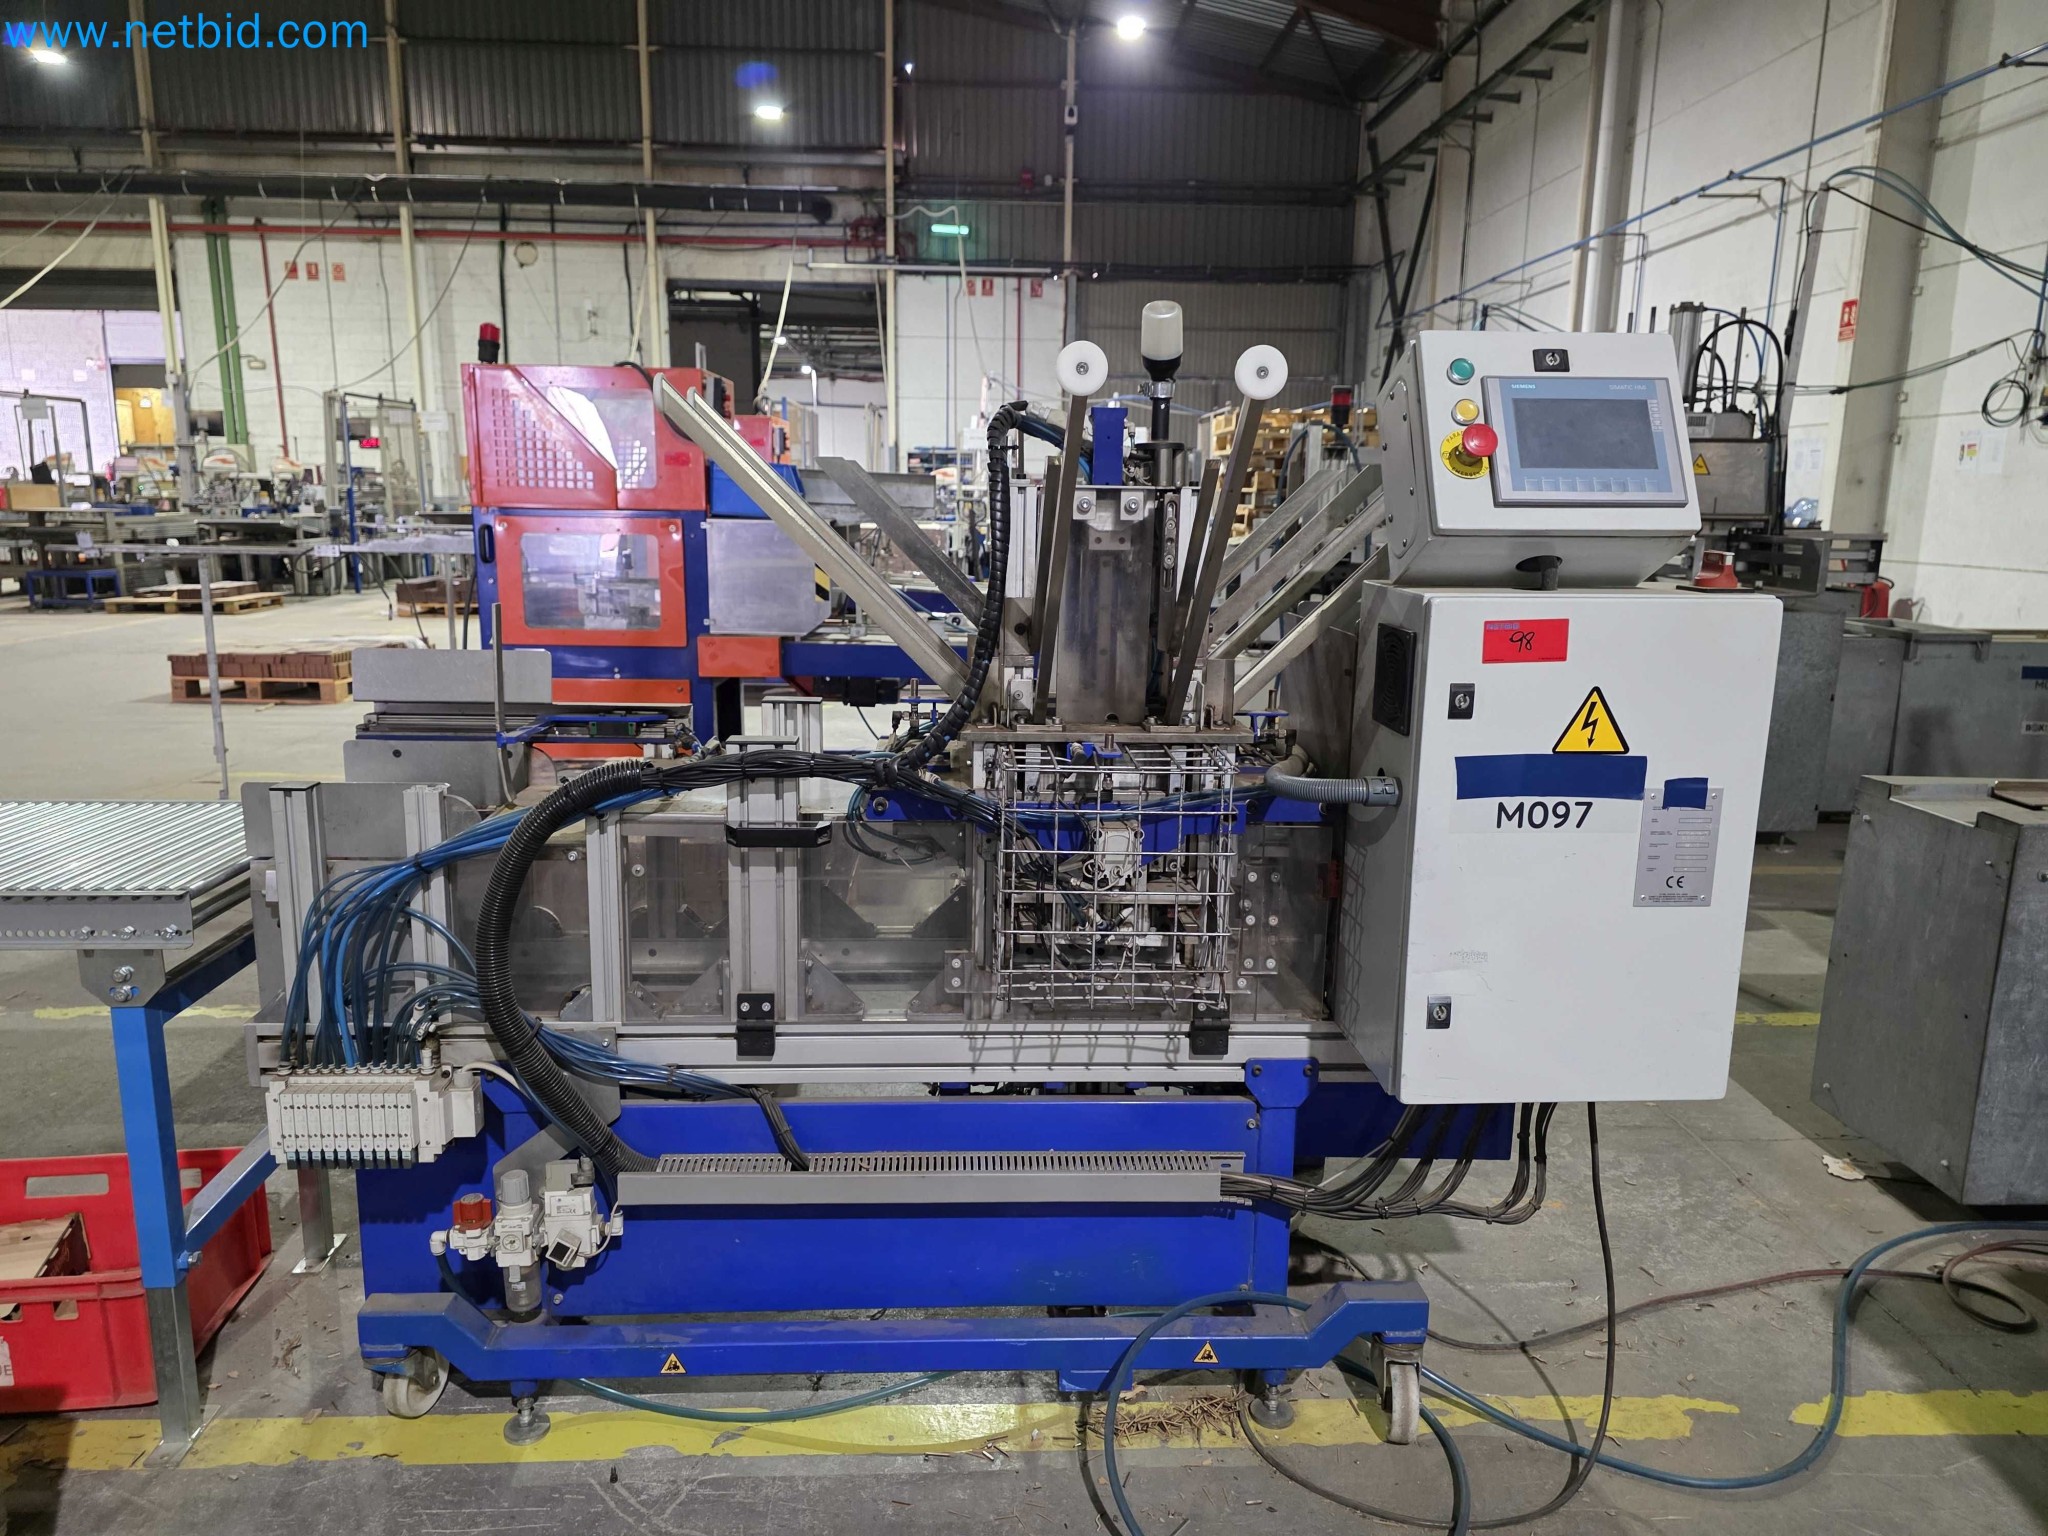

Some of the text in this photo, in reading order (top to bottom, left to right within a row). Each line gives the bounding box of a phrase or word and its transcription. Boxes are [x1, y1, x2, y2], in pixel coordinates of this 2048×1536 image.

[1649, 400, 1664, 431] TOUCH
[1509, 631, 1535, 653] 98
[1497, 801, 1593, 829] M097
